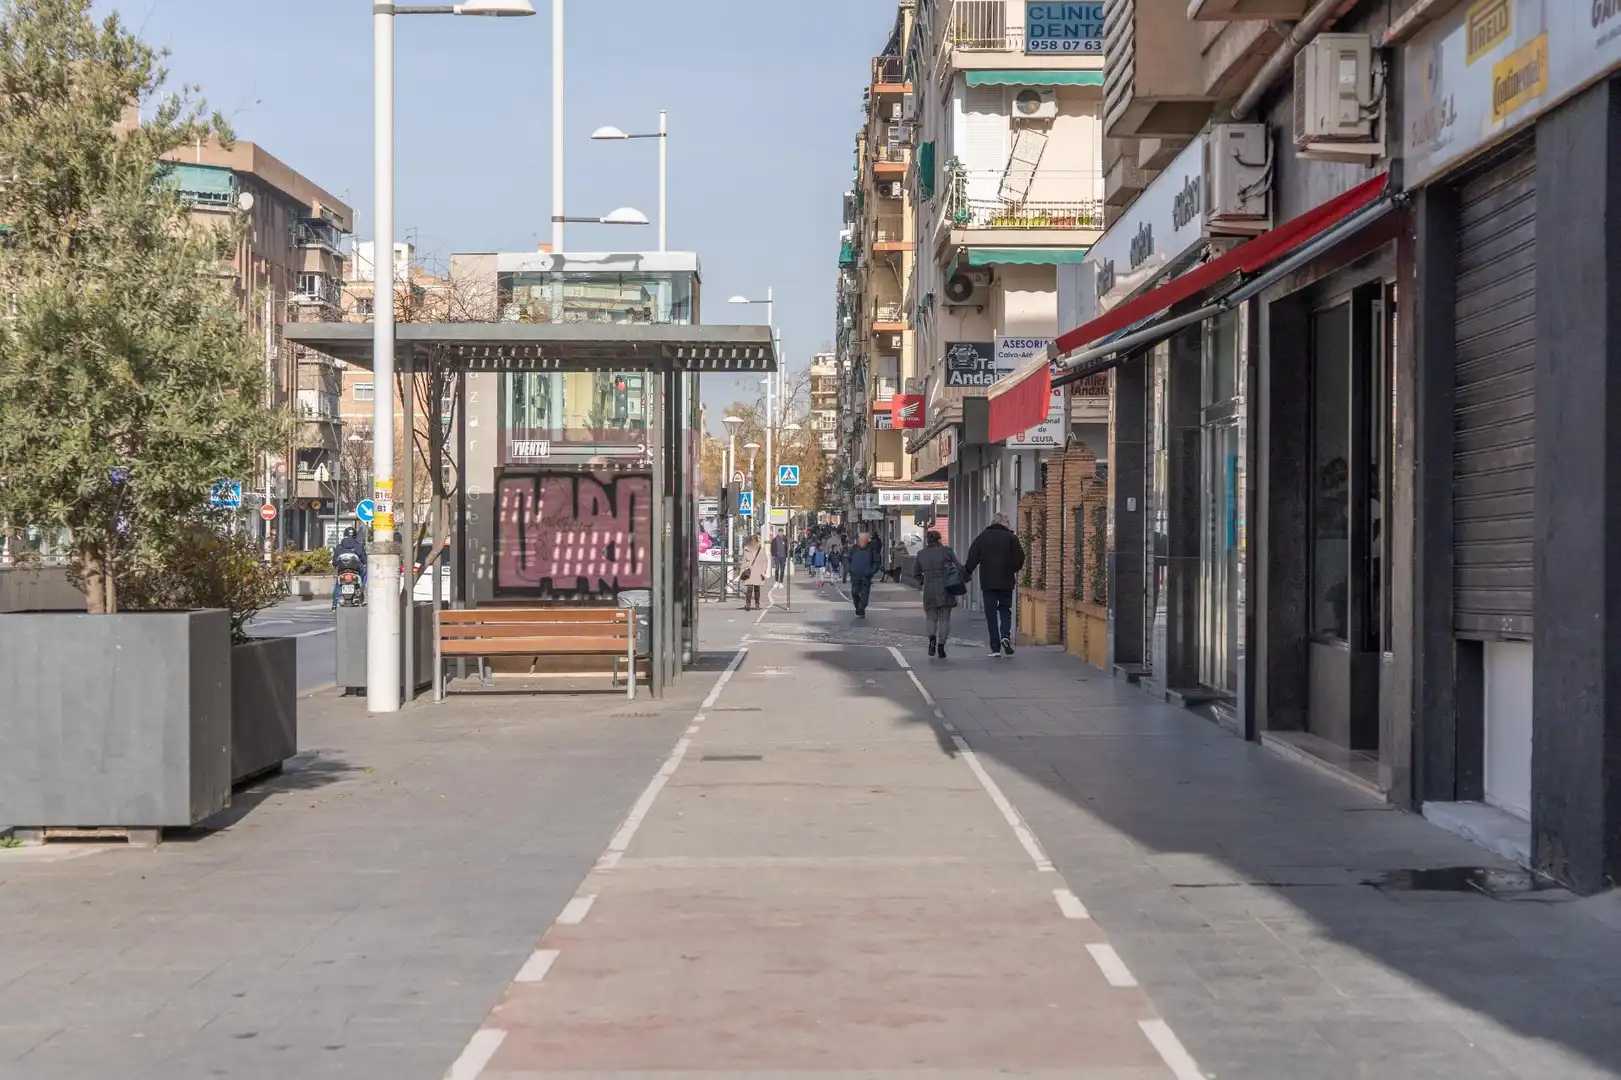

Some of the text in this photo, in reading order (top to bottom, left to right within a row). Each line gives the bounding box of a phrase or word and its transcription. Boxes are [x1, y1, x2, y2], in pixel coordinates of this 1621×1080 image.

[1031, 40, 1102, 50] 958 07 63
[1031, 435, 1054, 443] CEUTA
